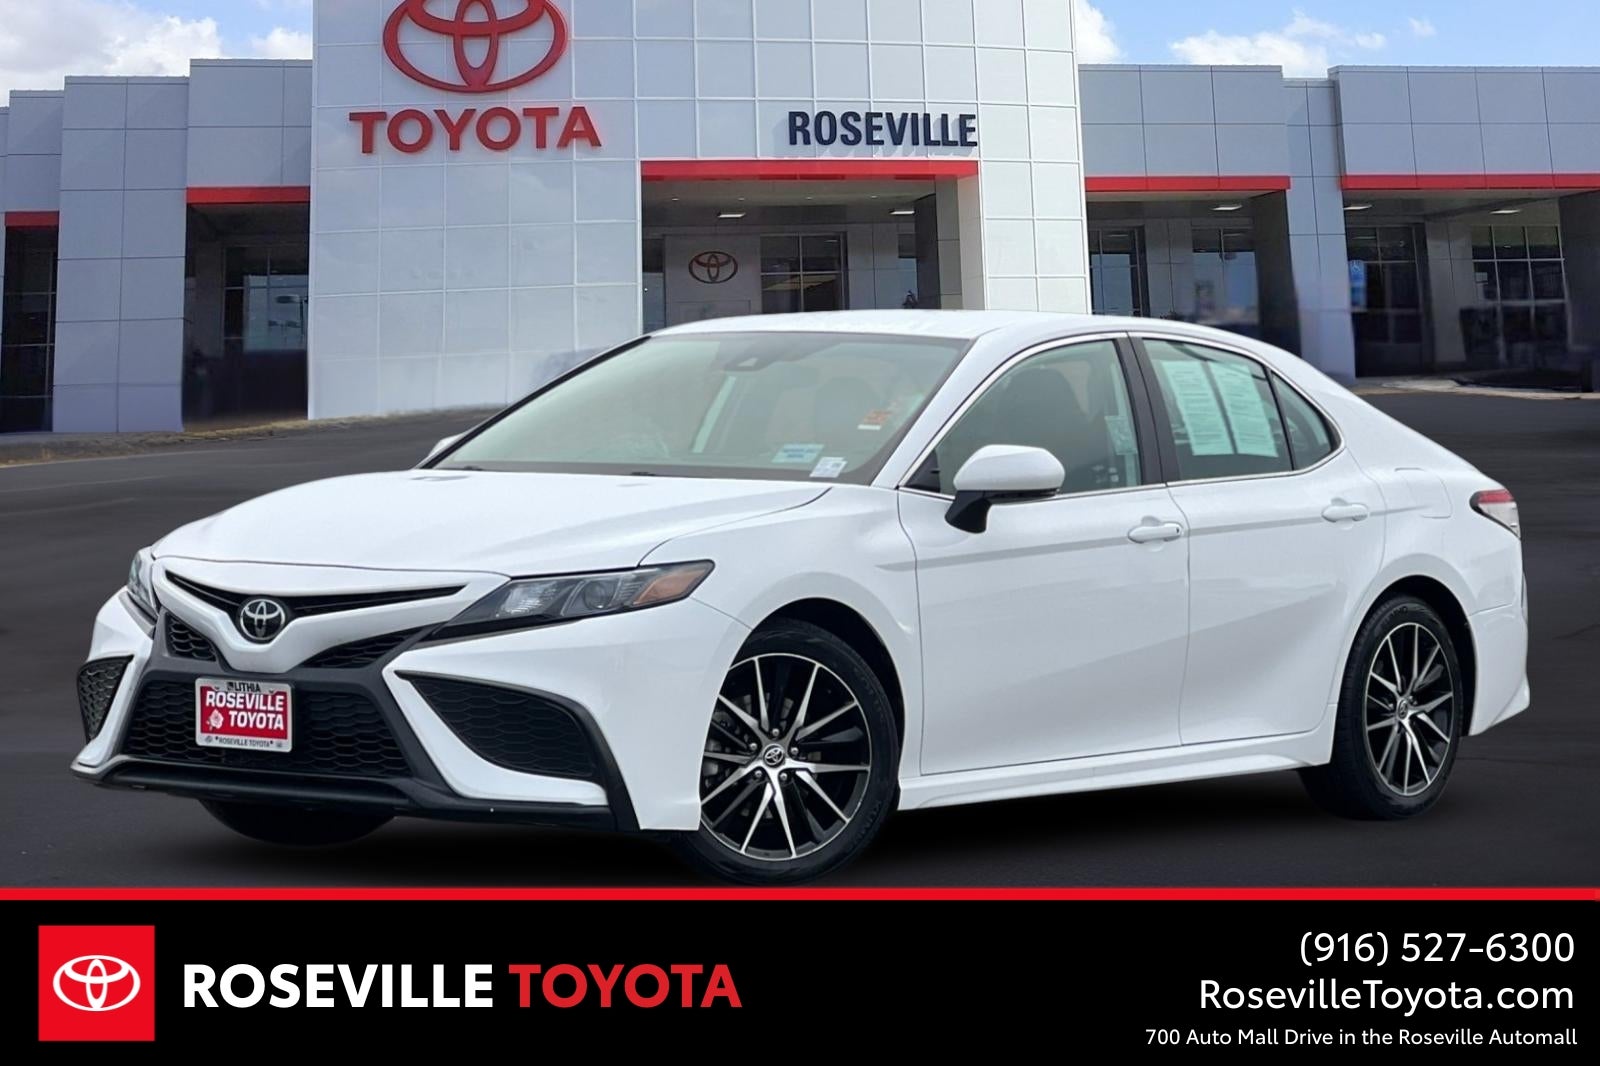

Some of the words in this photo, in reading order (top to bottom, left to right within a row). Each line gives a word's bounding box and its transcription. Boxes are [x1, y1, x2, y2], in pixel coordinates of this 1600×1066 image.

[349, 106, 602, 154] TOYOTA
[788, 110, 979, 148] ROSEVILLE
[234, 682, 261, 692] LITHIA
[206, 690, 284, 711] ROSEVILLE
[228, 711, 284, 730] TOYOTA
